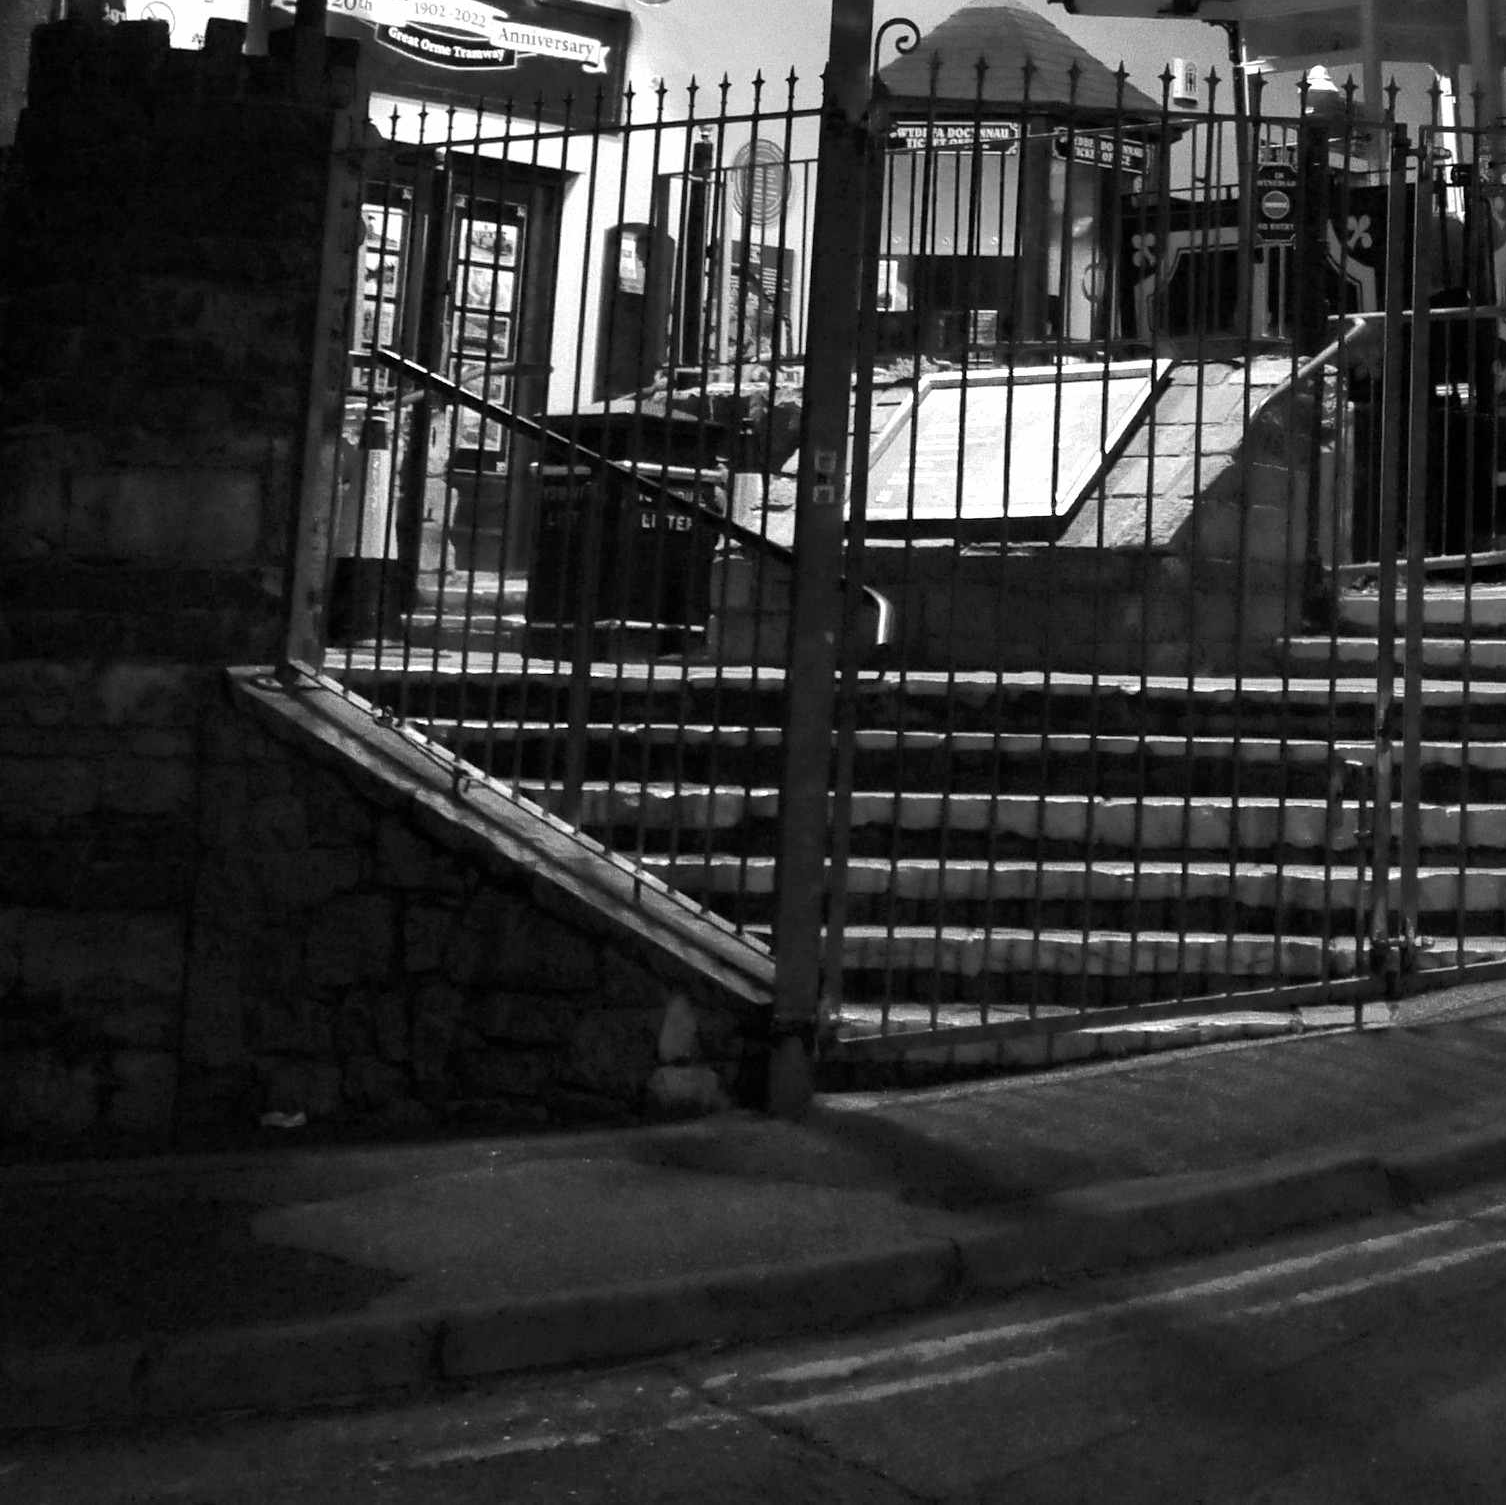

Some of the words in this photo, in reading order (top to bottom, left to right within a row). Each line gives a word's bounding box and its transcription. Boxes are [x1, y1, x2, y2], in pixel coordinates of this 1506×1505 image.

[414, 2, 487, 29] 1902-2022
[388, 26, 419, 48] Great
[420, 38, 451, 57] Orme
[453, 46, 506, 62] Tramway
[499, 27, 595, 59] Anniversary
[906, 137, 946, 148] TICET
[640, 512, 694, 532] LITER
